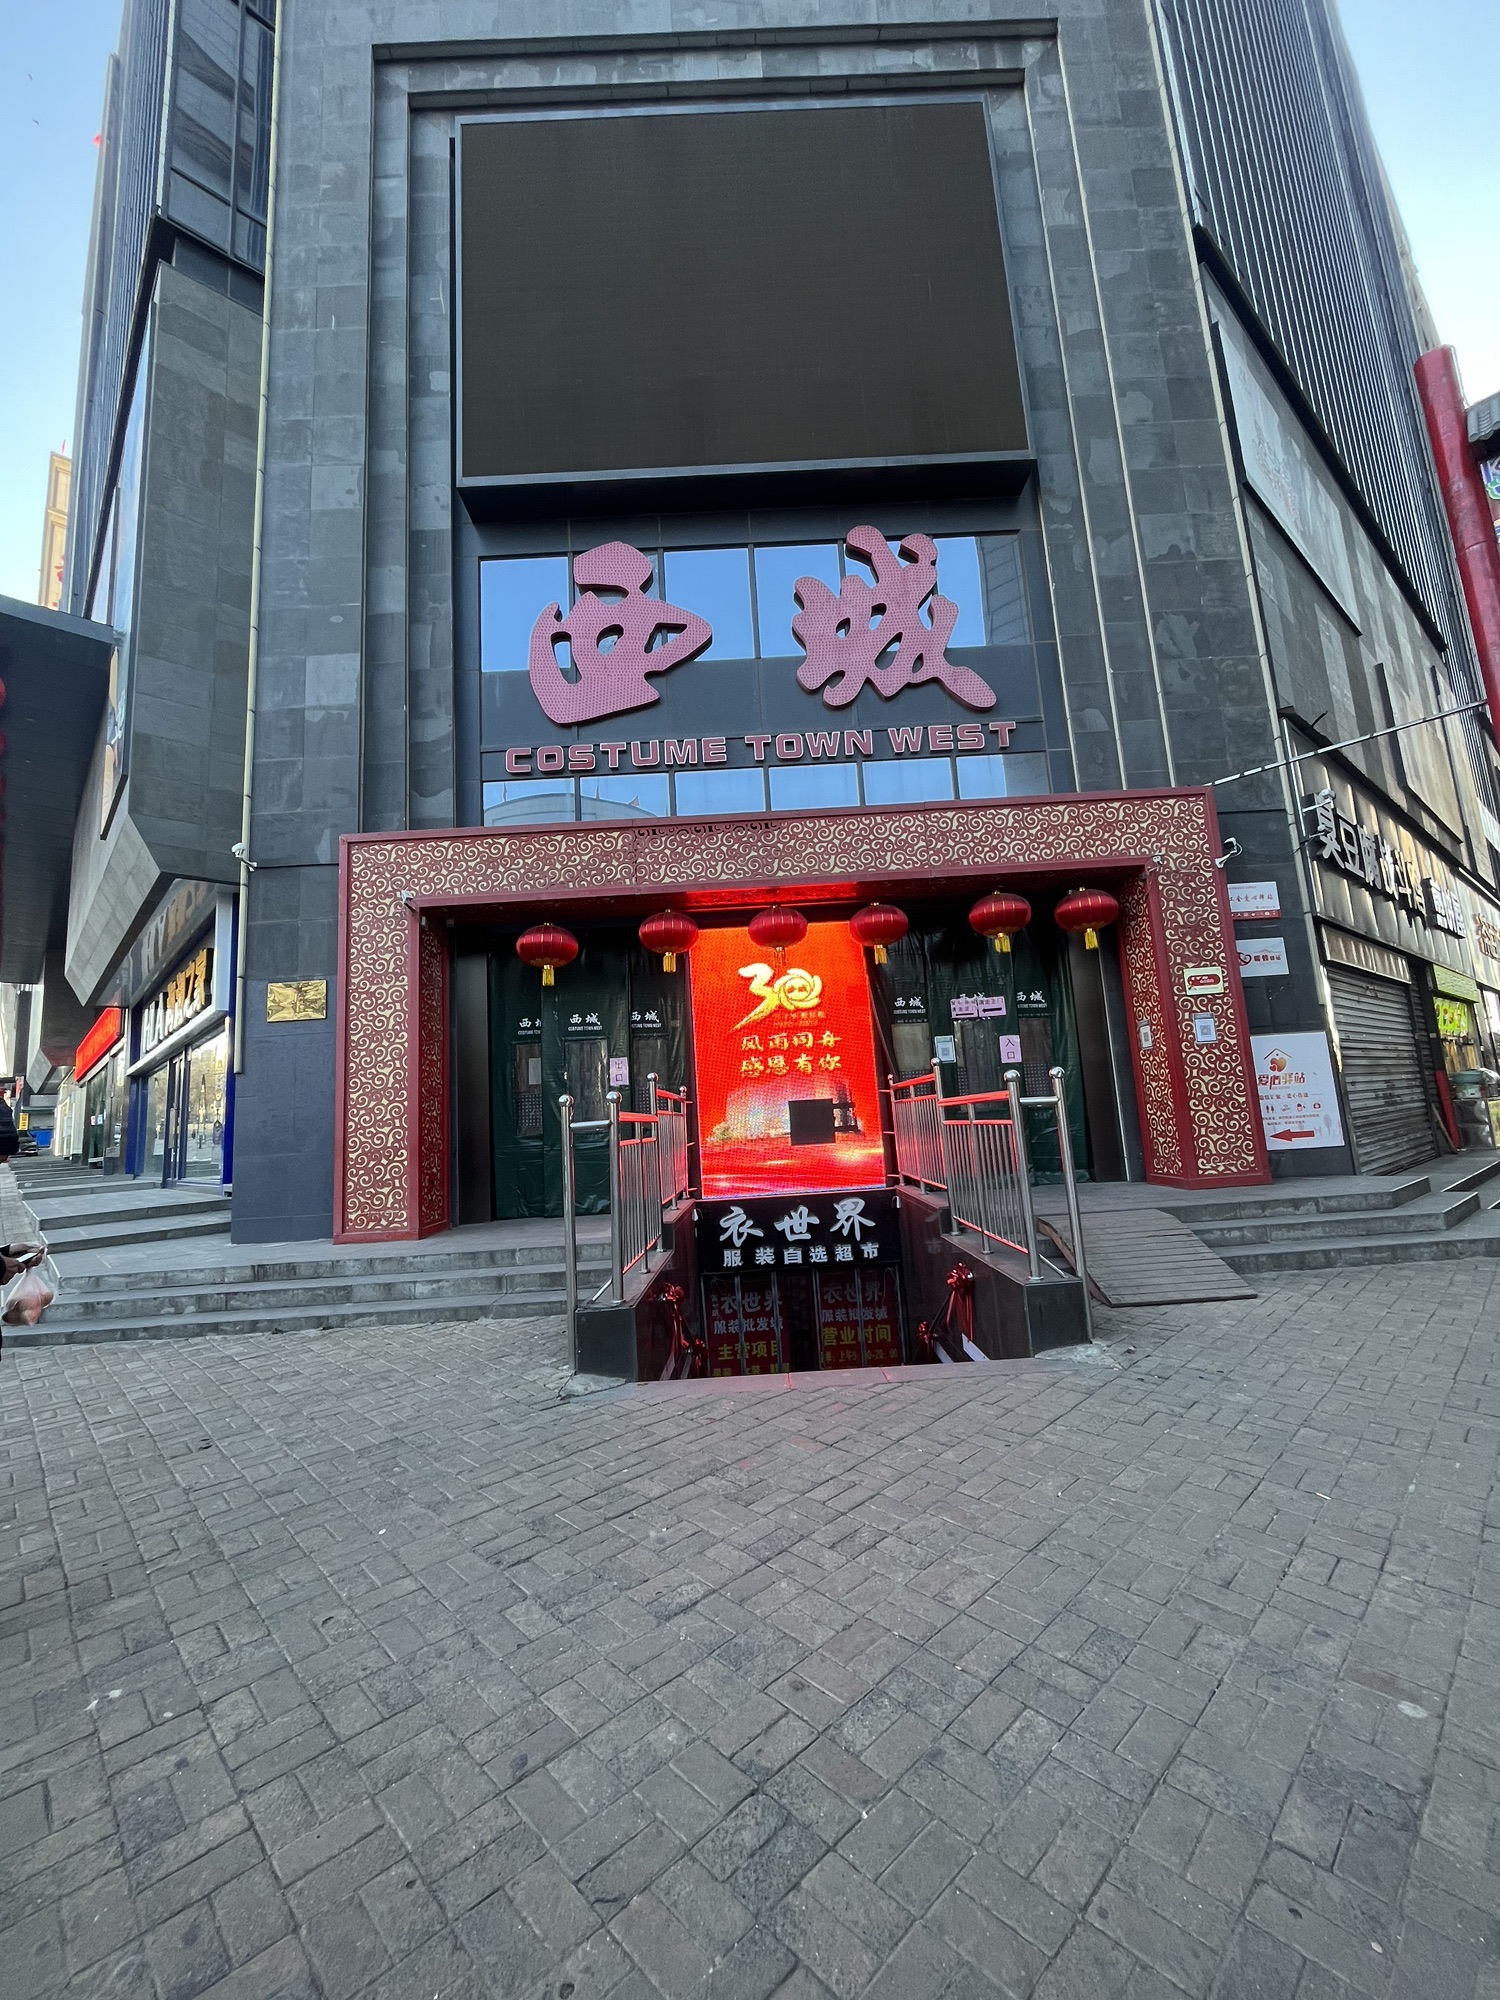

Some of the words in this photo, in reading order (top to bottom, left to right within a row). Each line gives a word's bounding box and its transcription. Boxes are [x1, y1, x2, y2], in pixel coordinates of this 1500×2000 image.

[529, 525, 997, 726] 西城
[505, 737, 728, 774] COSTUME
[745, 729, 873, 761] TOWN
[888, 721, 1016, 754] WEST
[894, 996, 924, 1009] 西城
[570, 1012, 600, 1026] 西城
[631, 1010, 660, 1023] 西城
[741, 1030, 842, 1051] 风雨同舟
[1005, 1038, 1015, 1059] 入口
[615, 1059, 623, 1082] 出口
[741, 1053, 842, 1078] 感恩有你
[719, 1196, 876, 1247] 衣世界
[723, 1242, 880, 1267] 服装自选超市
[822, 1324, 892, 1346] 营业时间
